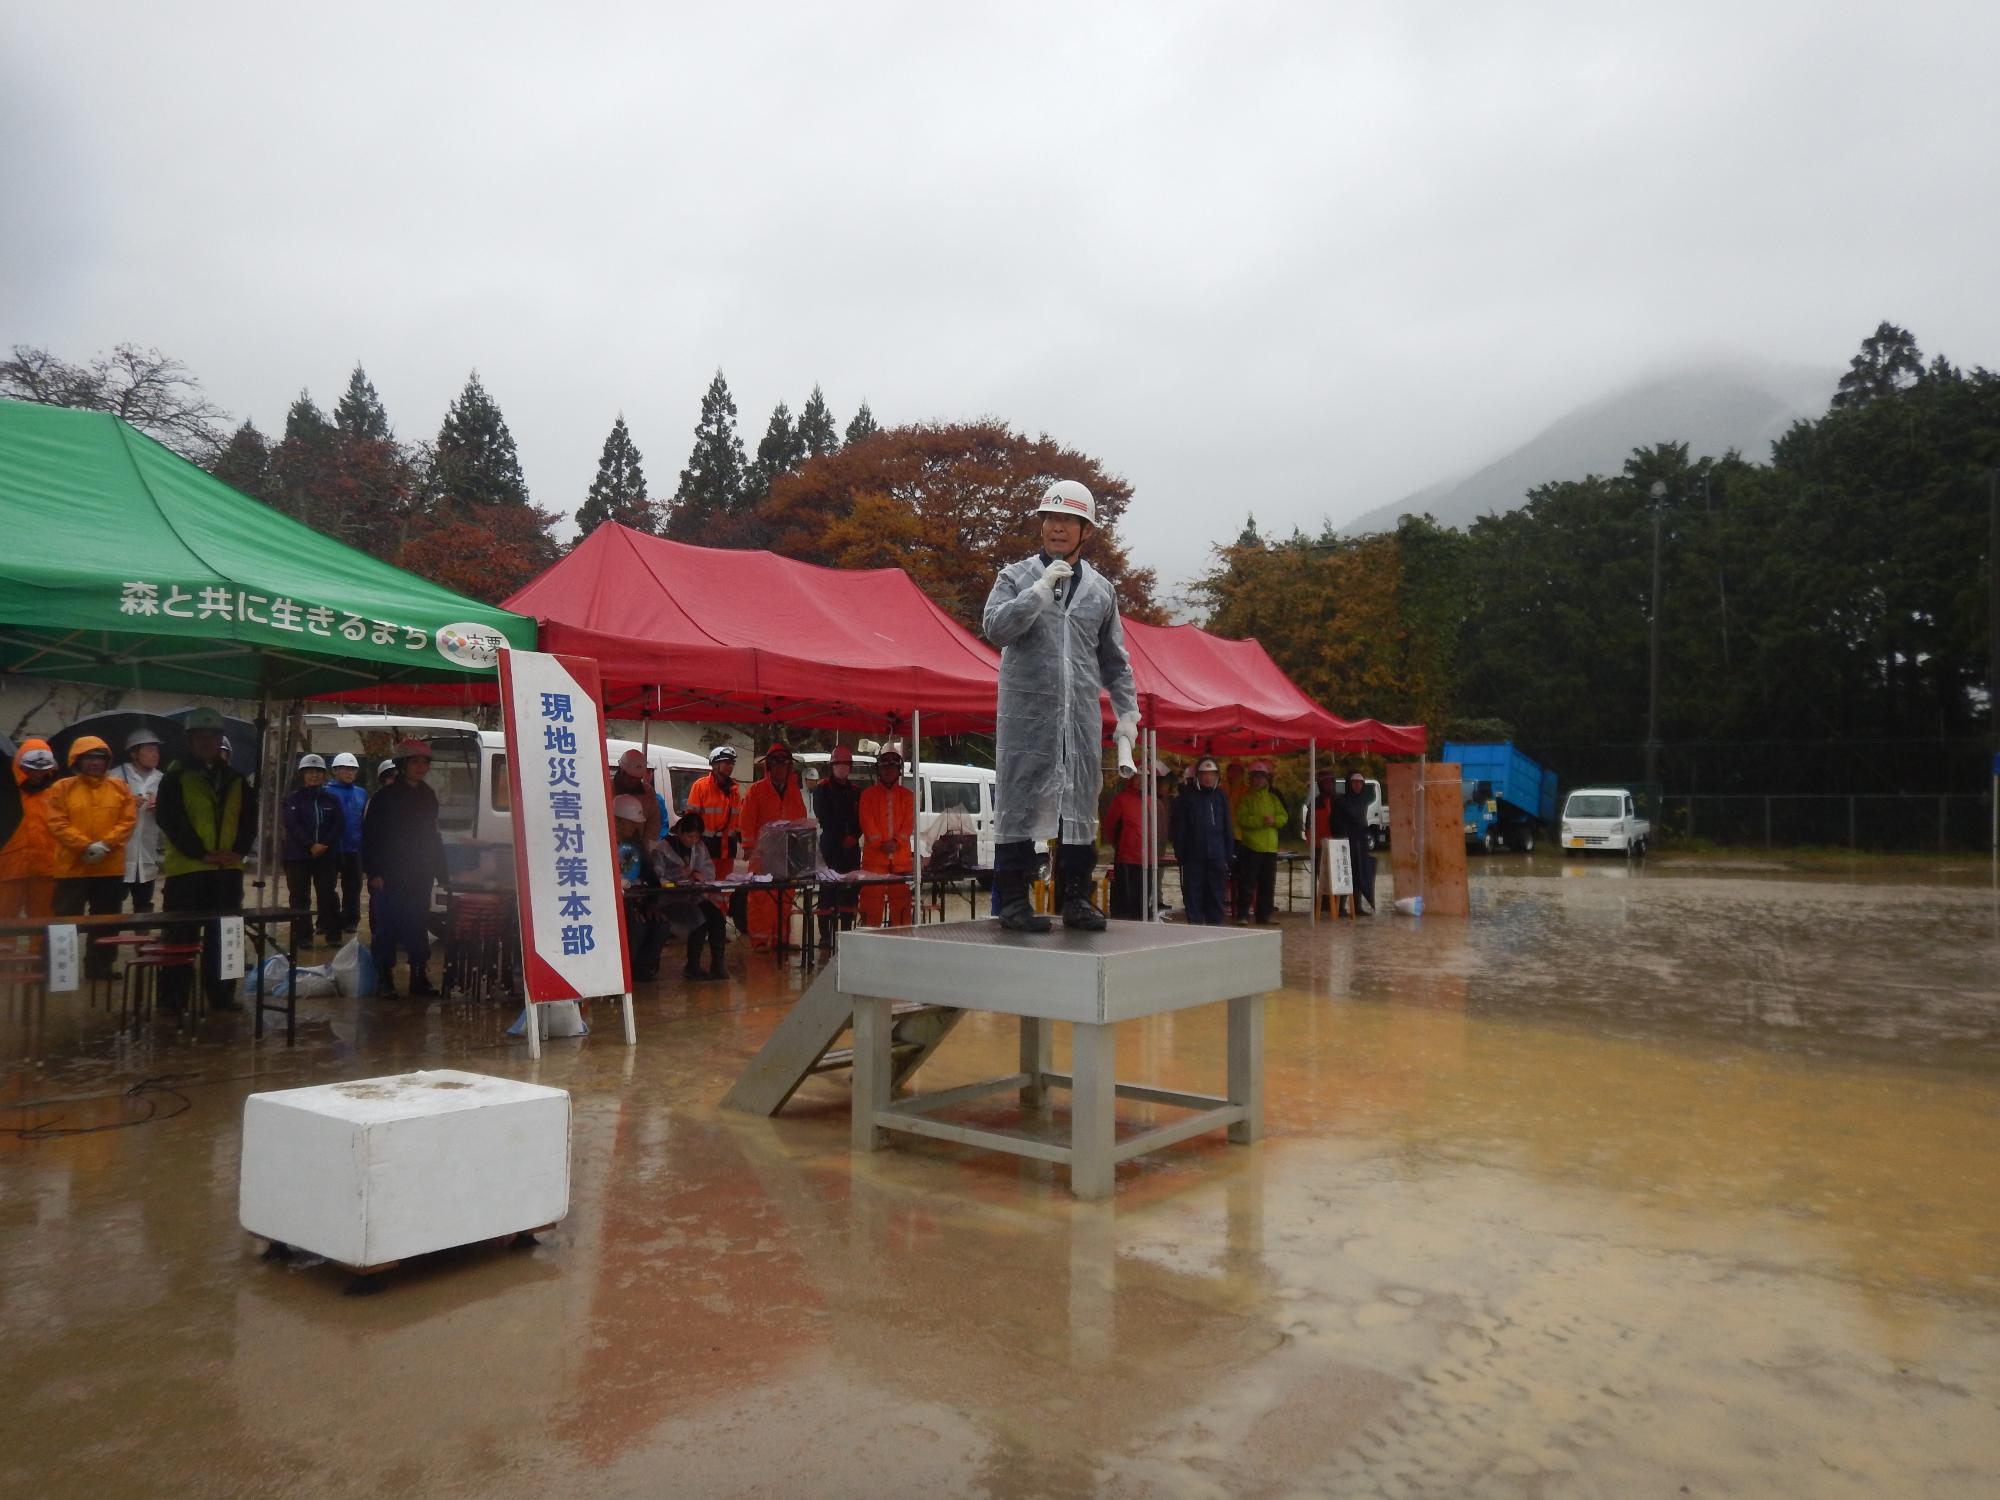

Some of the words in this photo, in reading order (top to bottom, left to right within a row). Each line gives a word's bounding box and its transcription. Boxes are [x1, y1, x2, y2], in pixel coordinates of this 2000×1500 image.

[120, 581, 427, 649] 森と共に生きるまち
[540, 692, 596, 956] 現地災害対策本部
